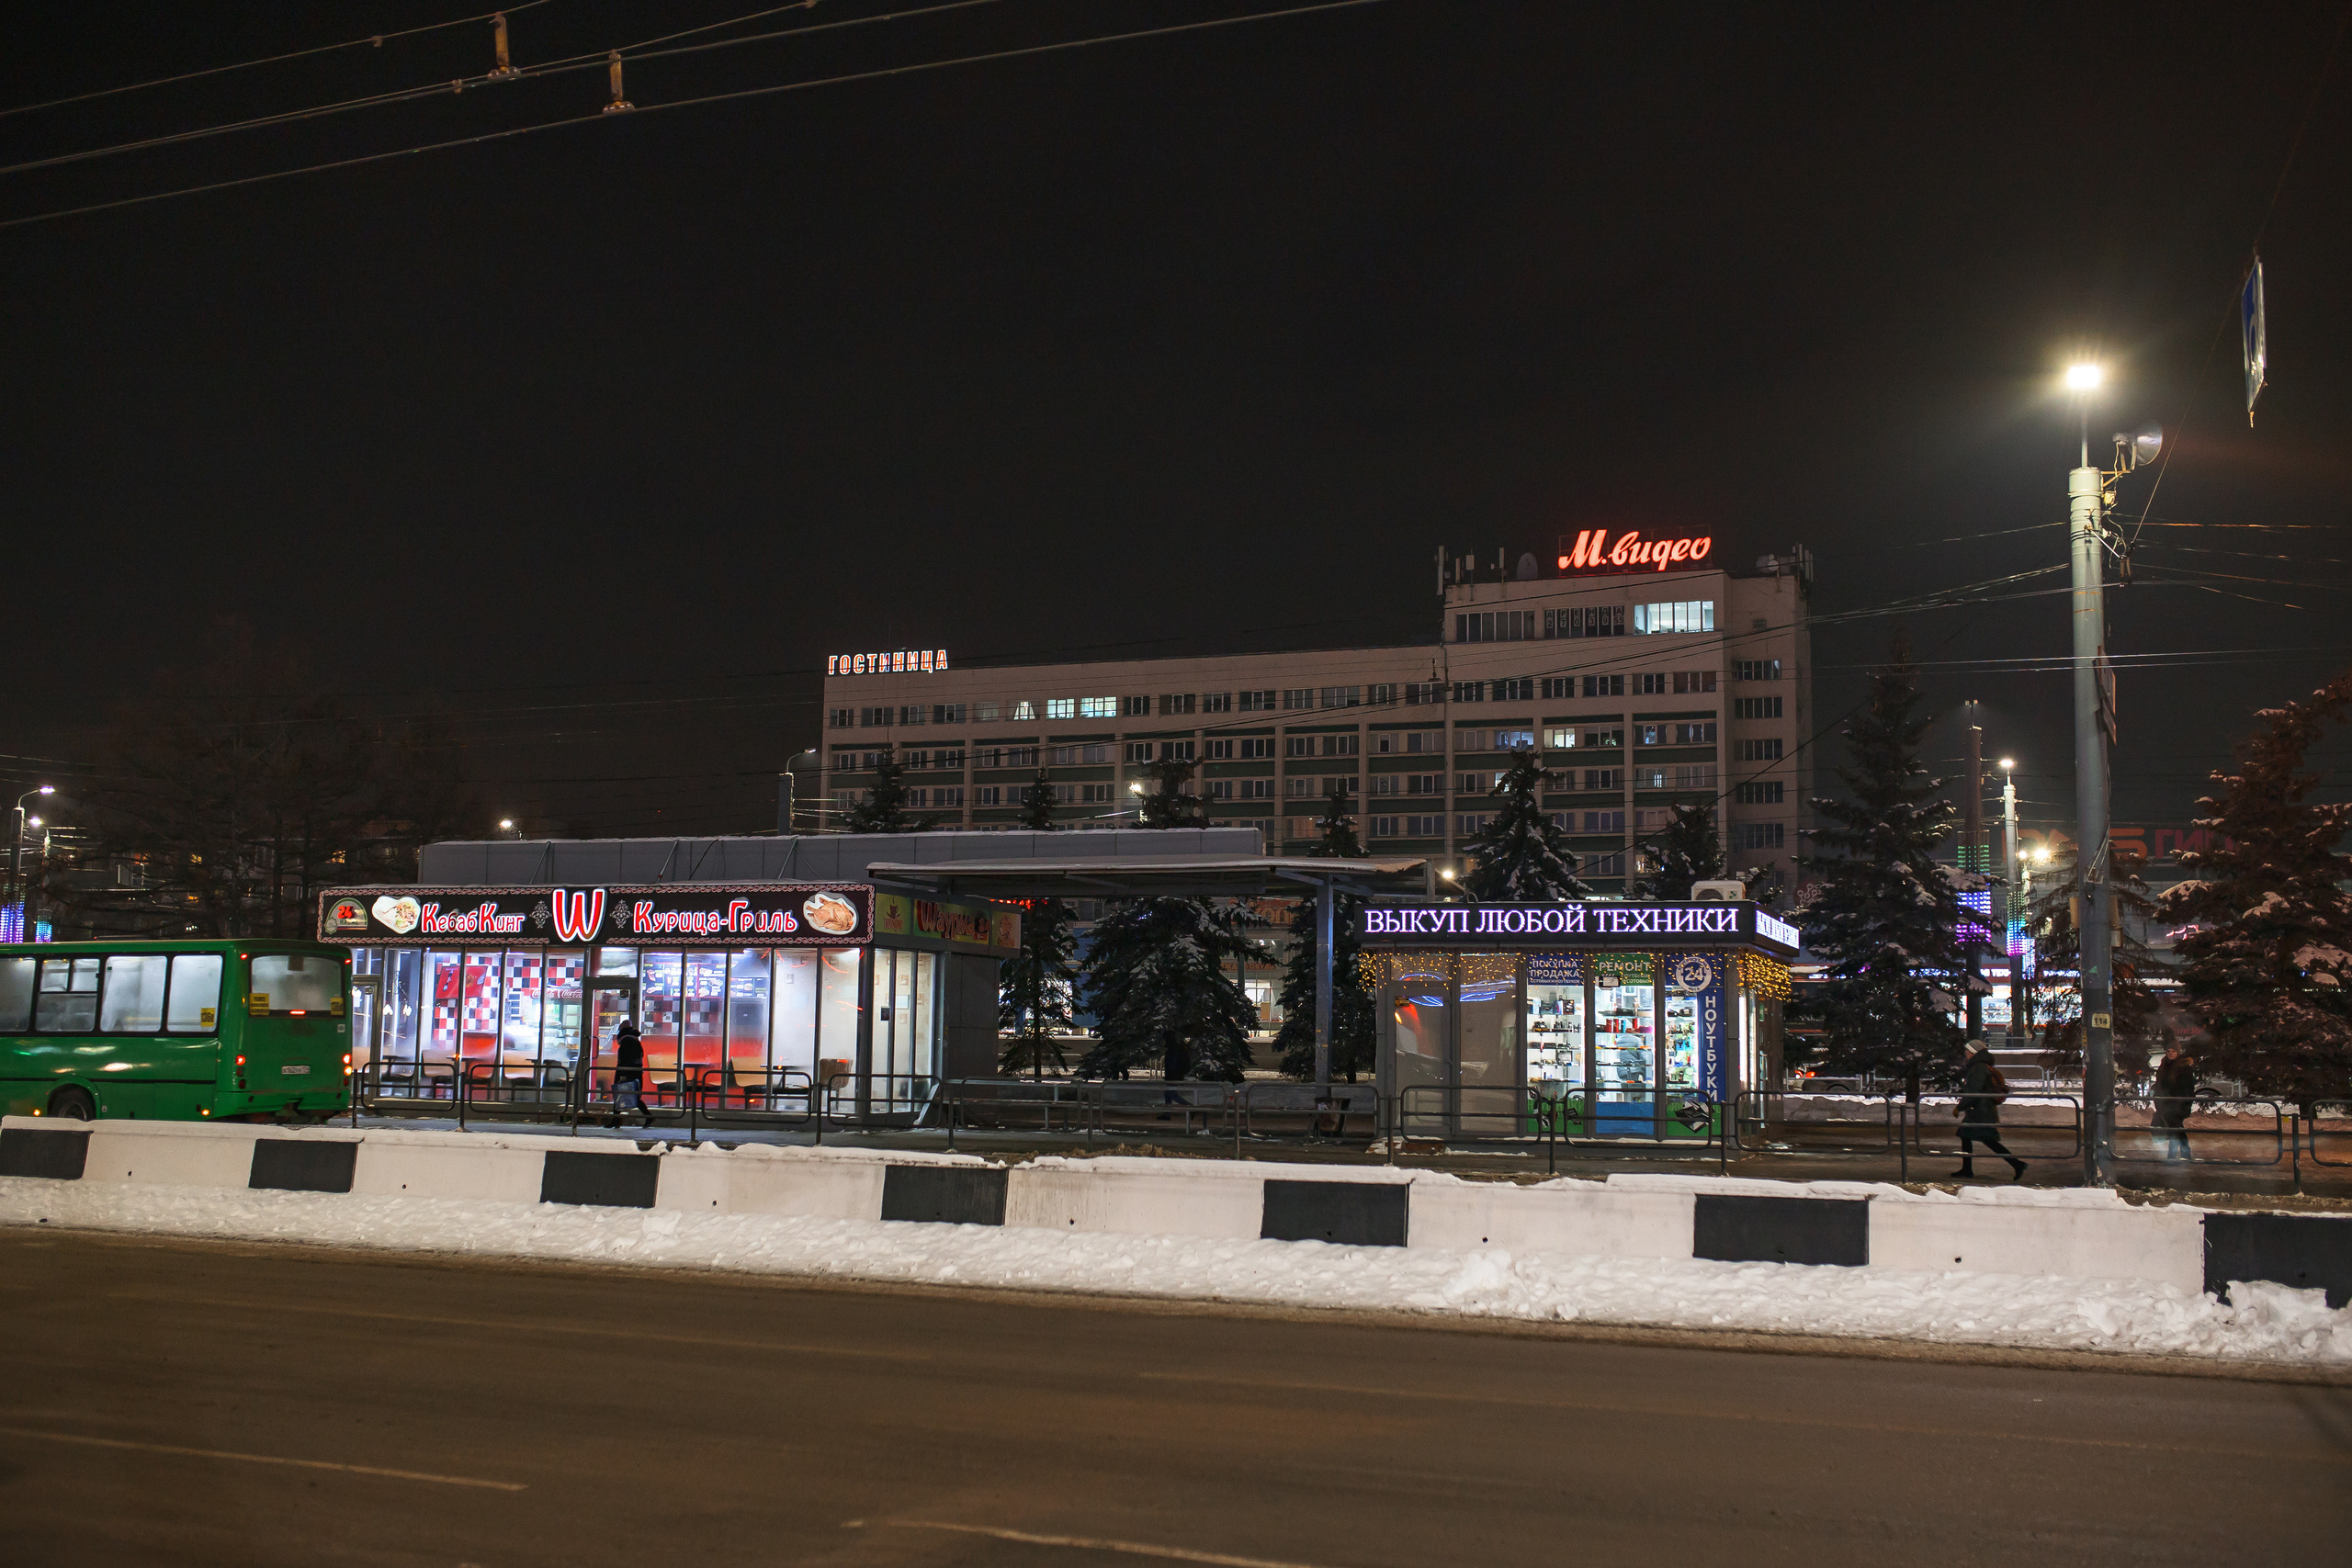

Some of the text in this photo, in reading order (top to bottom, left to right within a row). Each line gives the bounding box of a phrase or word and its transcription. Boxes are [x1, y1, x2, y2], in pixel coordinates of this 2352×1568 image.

[1558, 529, 1712, 571] М.видео
[828, 649, 949, 675] ГОСТИНИЦА
[633, 899, 798, 935] Курица-Гриль
[1365, 908, 1470, 933] ВЫКУП
[1476, 903, 1589, 933] ЛЮБОЙ
[1593, 908, 1740, 933] ТЕХНИКИ
[1531, 969, 1580, 978] ПРОДАЖА
[1532, 960, 1578, 968] ПОКУПКА
[1599, 962, 1651, 972] РЕМОНТ
[1684, 966, 1704, 981] 24
[2094, 1017, 2108, 1025] 114
[1704, 995, 1718, 1102] НОУТБУКИ
